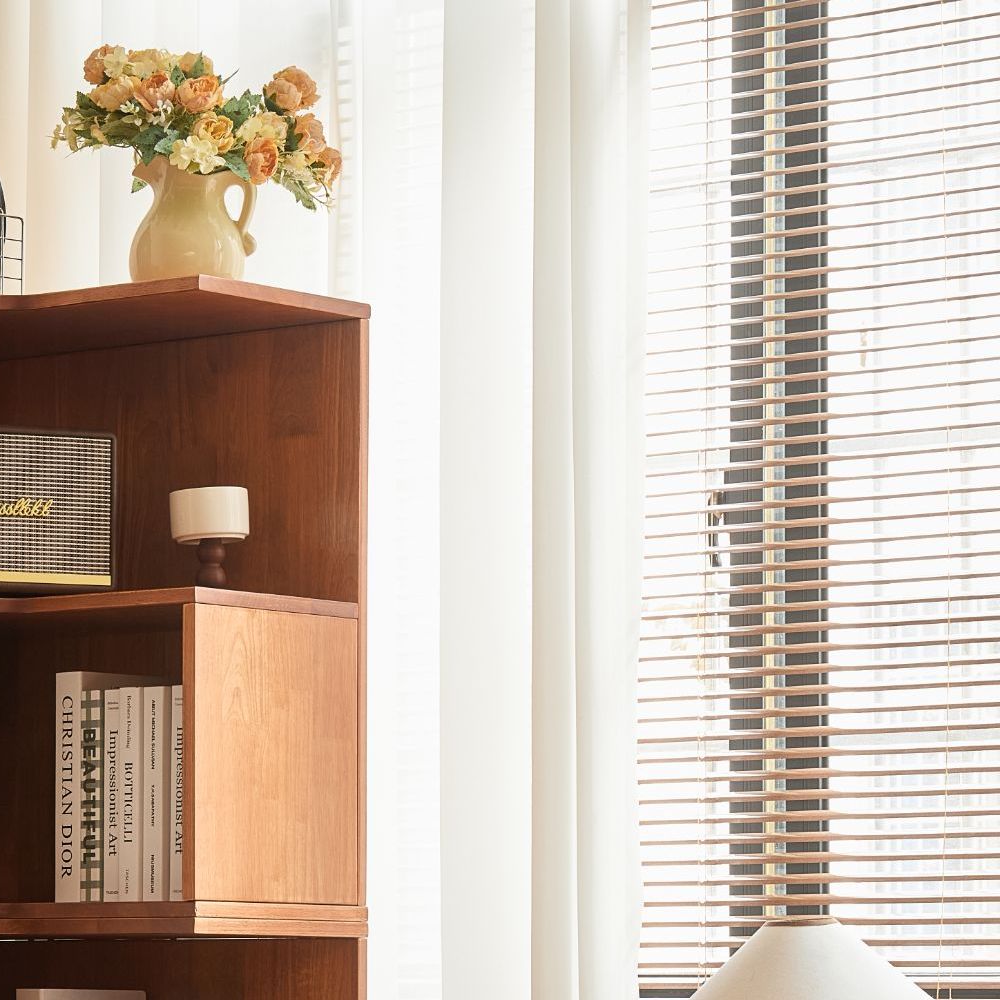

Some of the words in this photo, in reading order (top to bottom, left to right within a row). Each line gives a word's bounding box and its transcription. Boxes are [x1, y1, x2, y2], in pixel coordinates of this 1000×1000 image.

[61, 695, 74, 816] CHRISTIAN
[82, 729, 96, 864] BEAUTIFUL
[107, 730, 119, 829] Impressionist
[108, 833, 119, 857] Art
[123, 762, 134, 843] BOTTICELLI
[61, 824, 73, 878] DIOR
